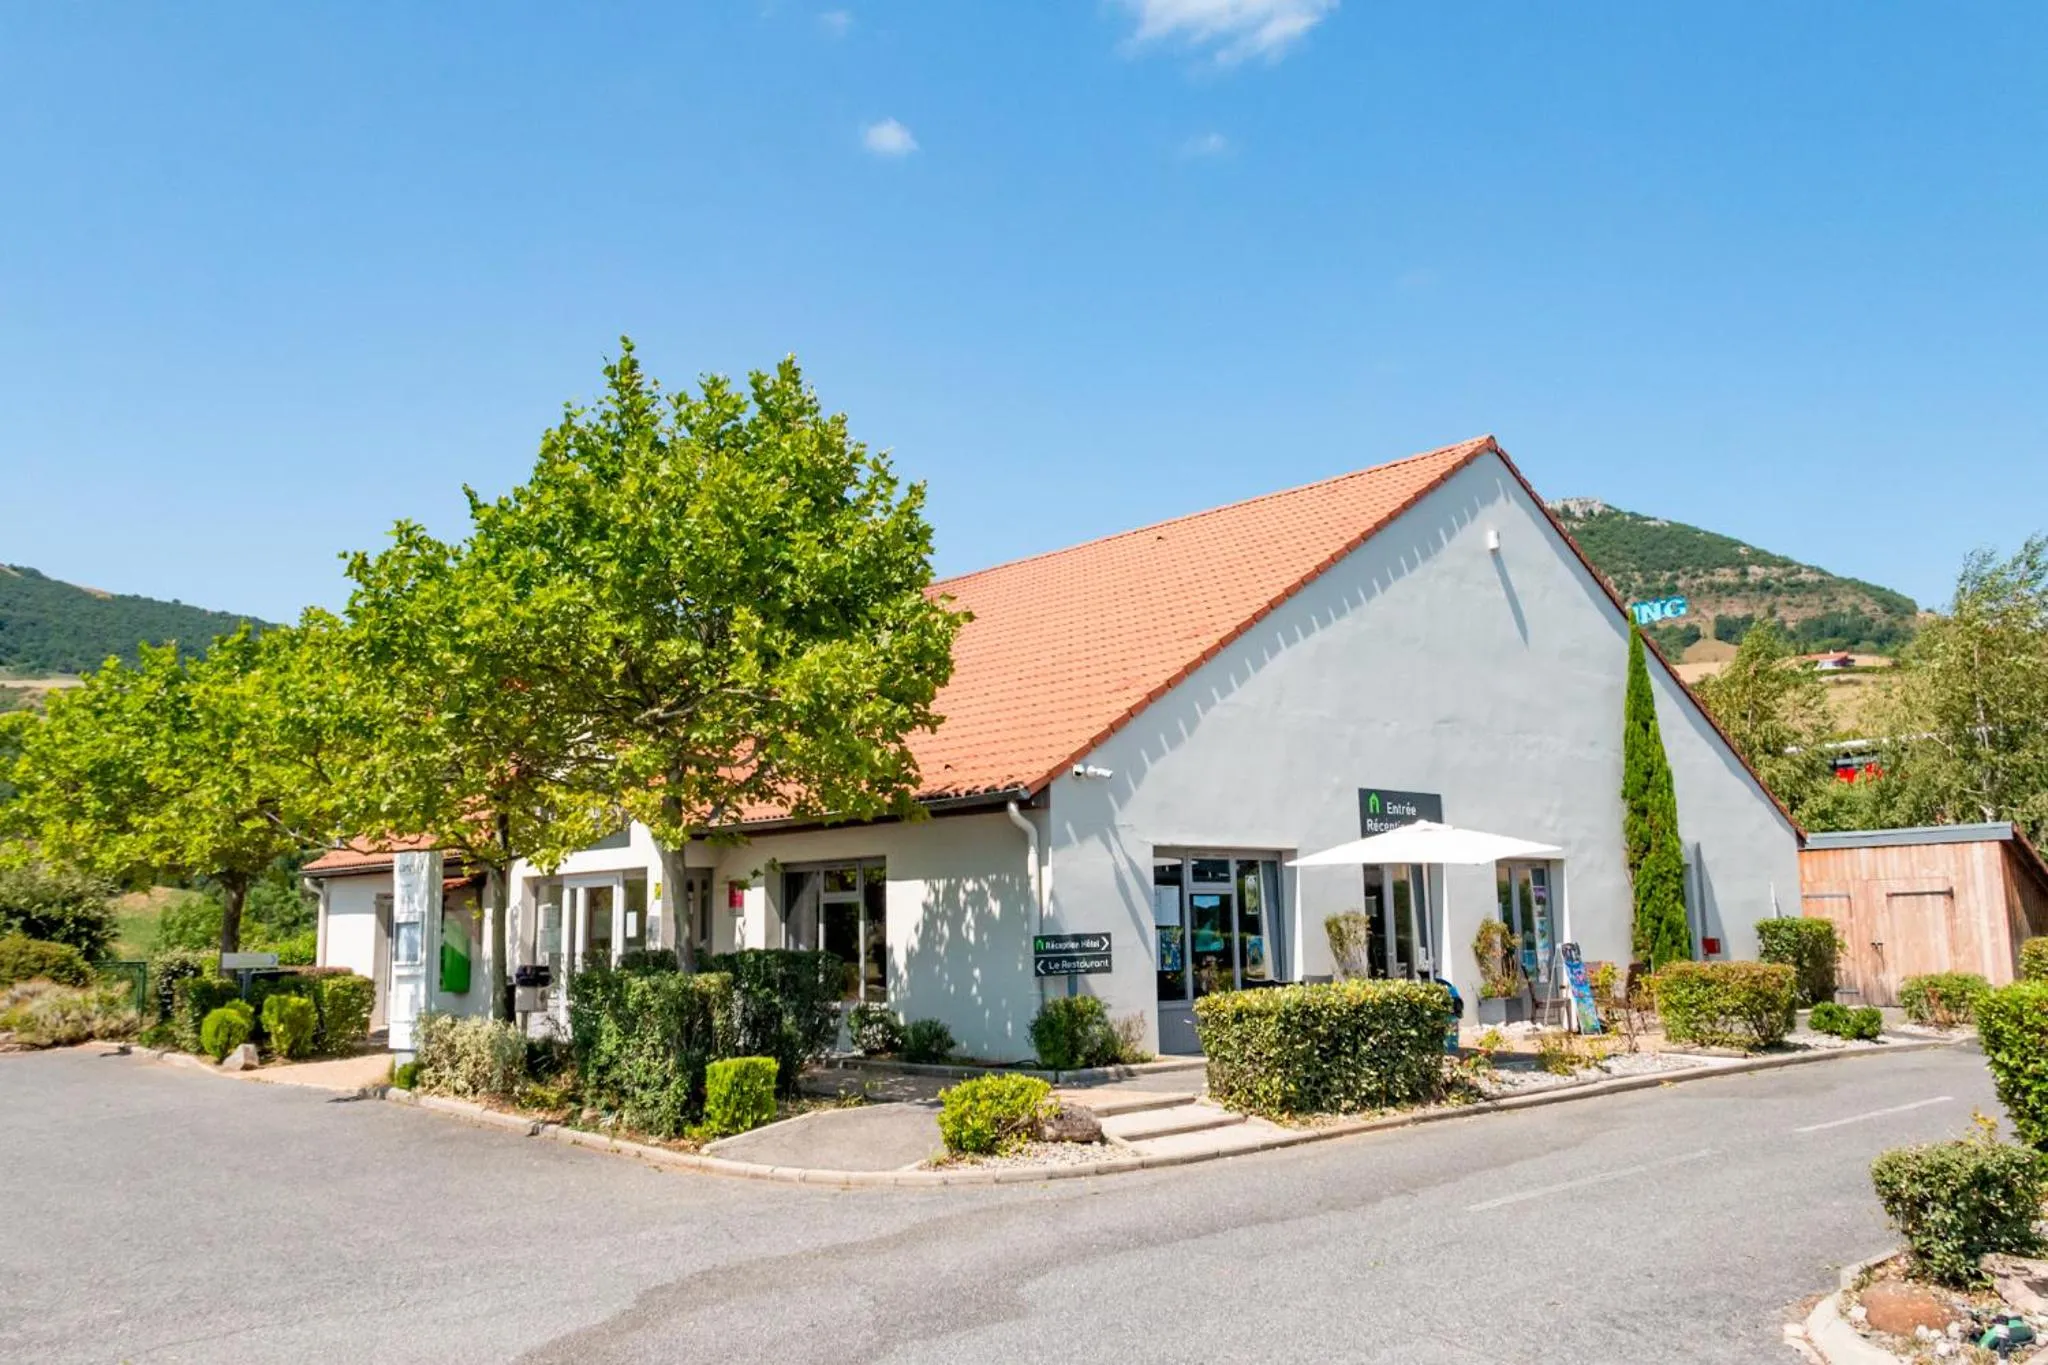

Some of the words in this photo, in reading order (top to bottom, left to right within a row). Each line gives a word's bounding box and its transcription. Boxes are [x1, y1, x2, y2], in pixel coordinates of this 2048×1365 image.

[1386, 801, 1417, 815] Entrée
[1081, 939, 1100, 949] Hôtel
[1048, 961, 1060, 970] Le
[1062, 958, 1109, 970] Restaurant
